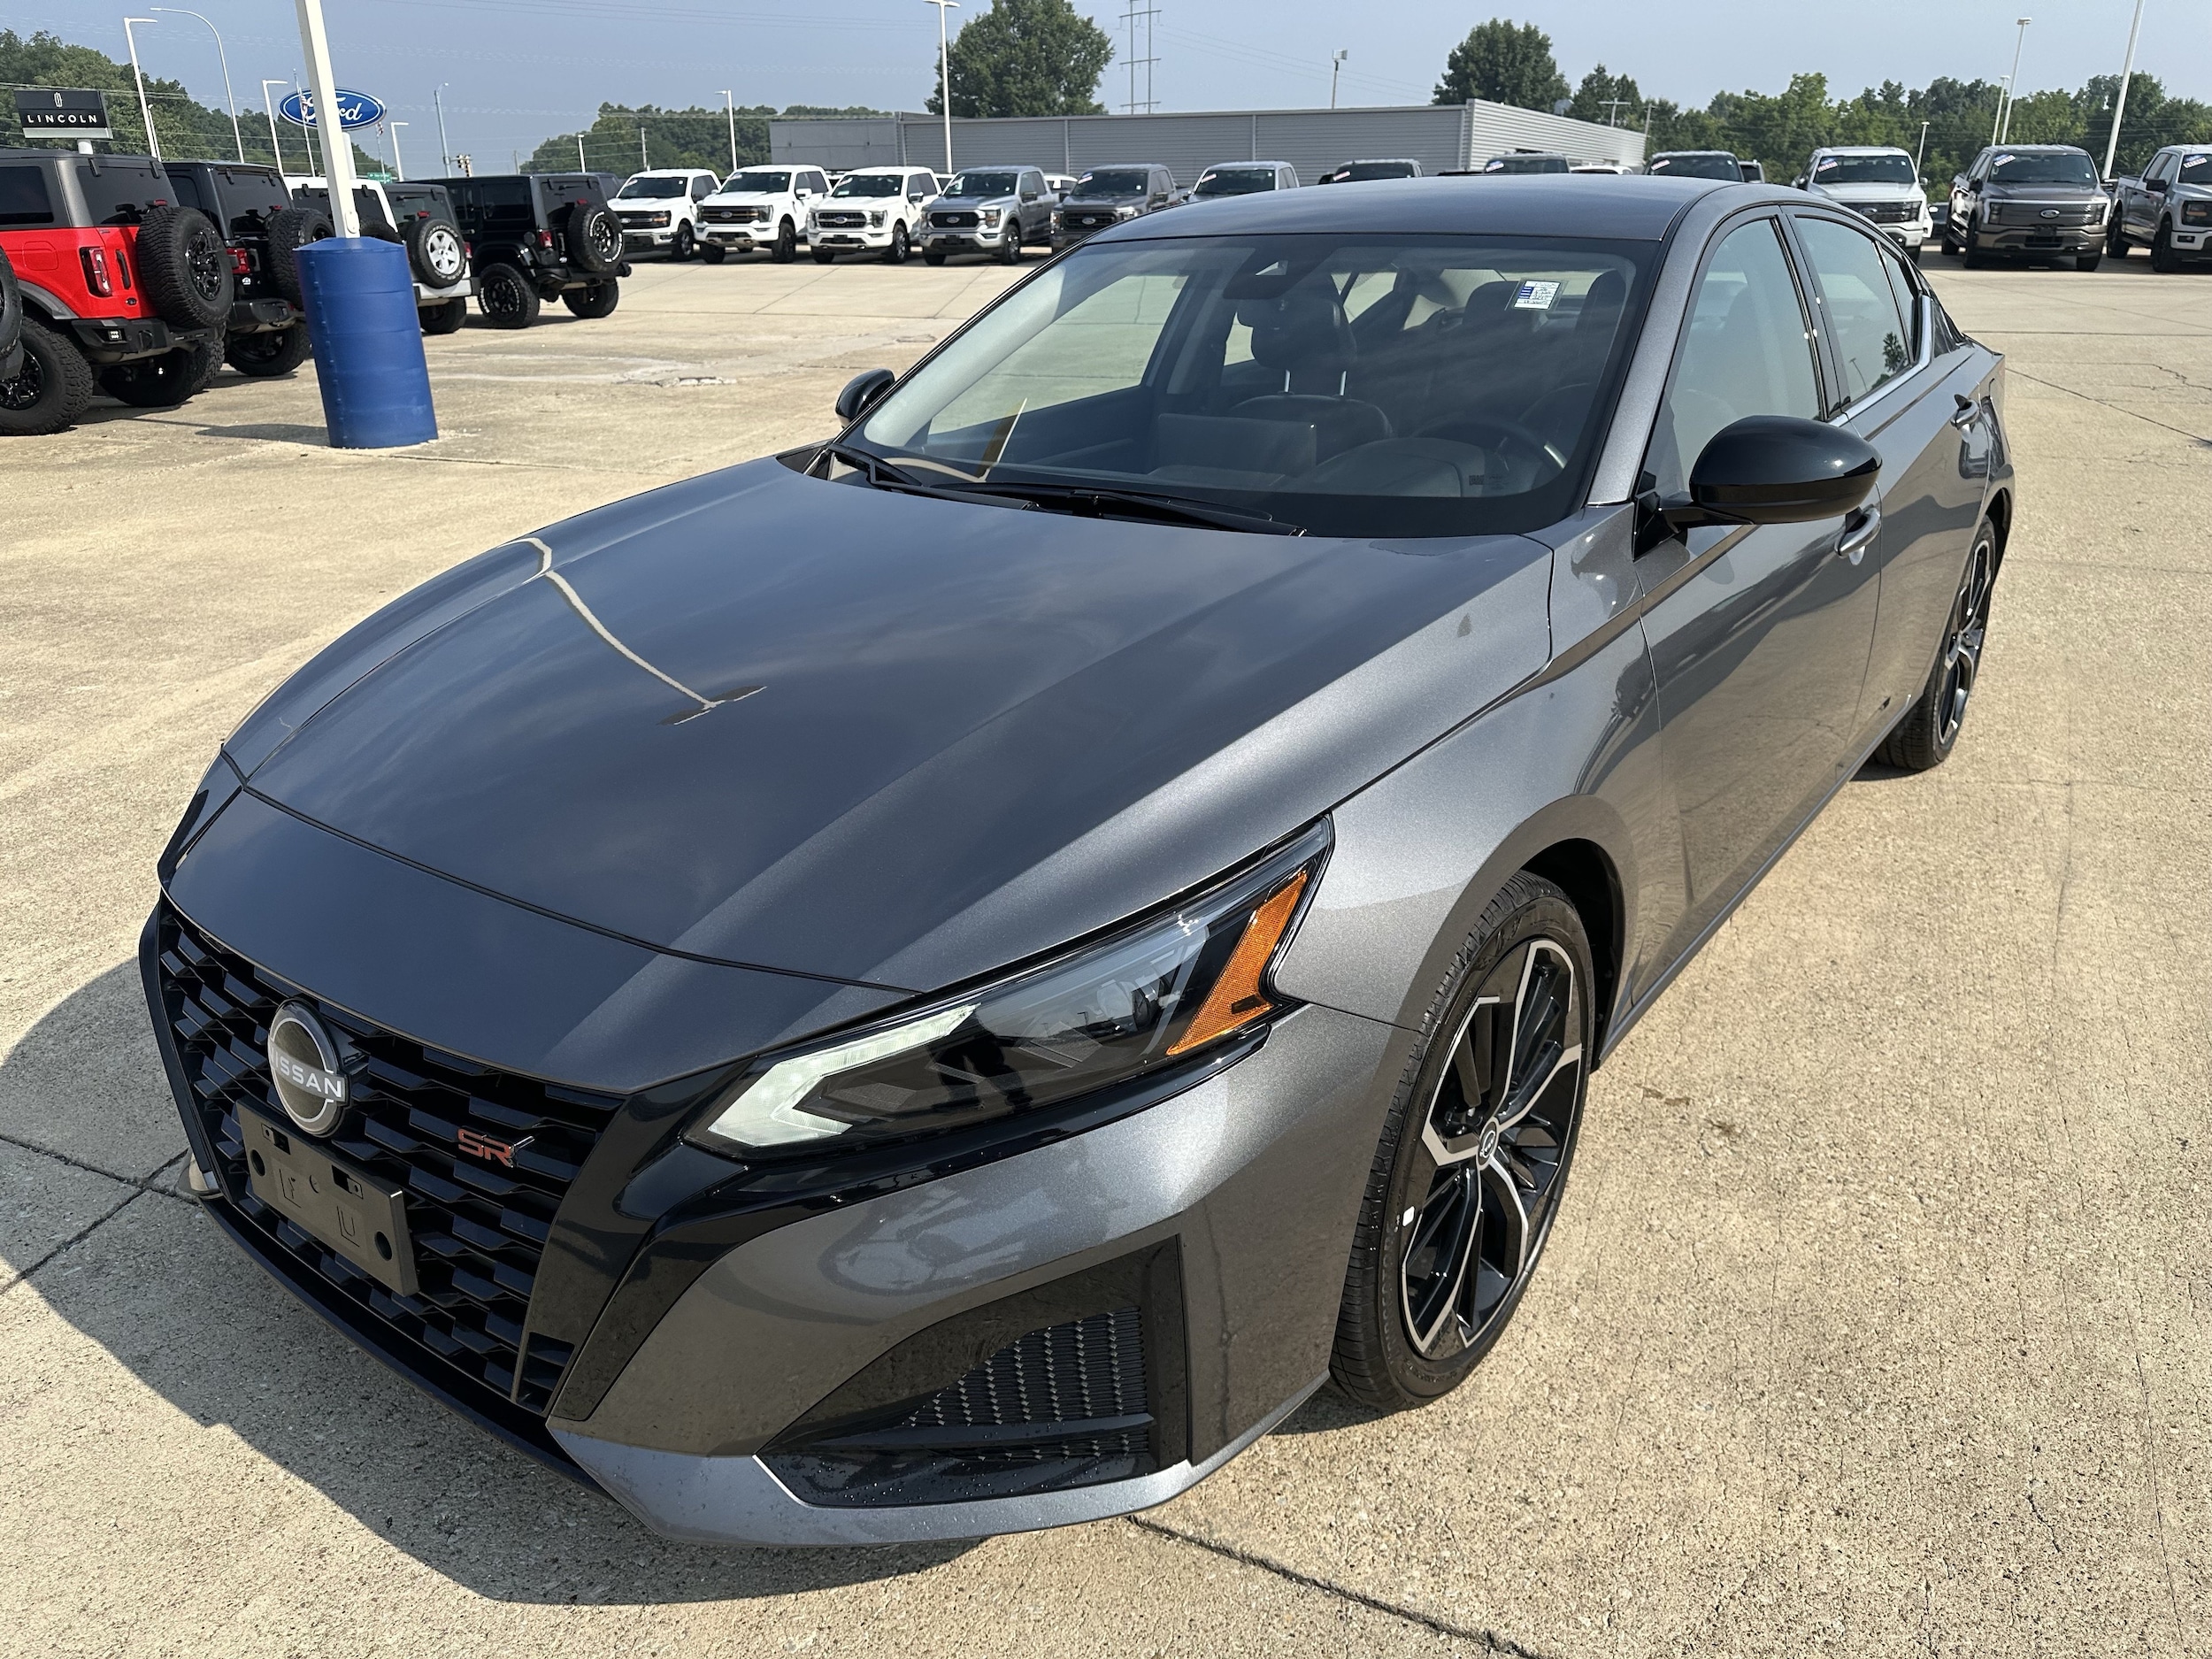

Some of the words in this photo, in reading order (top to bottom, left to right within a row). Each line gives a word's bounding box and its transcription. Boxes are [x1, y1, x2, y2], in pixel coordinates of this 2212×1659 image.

[27, 114, 97, 124] LINCOLN
[303, 96, 364, 121] rd
[268, 1041, 342, 1098] NISSAN
[457, 1128, 514, 1168] SR
